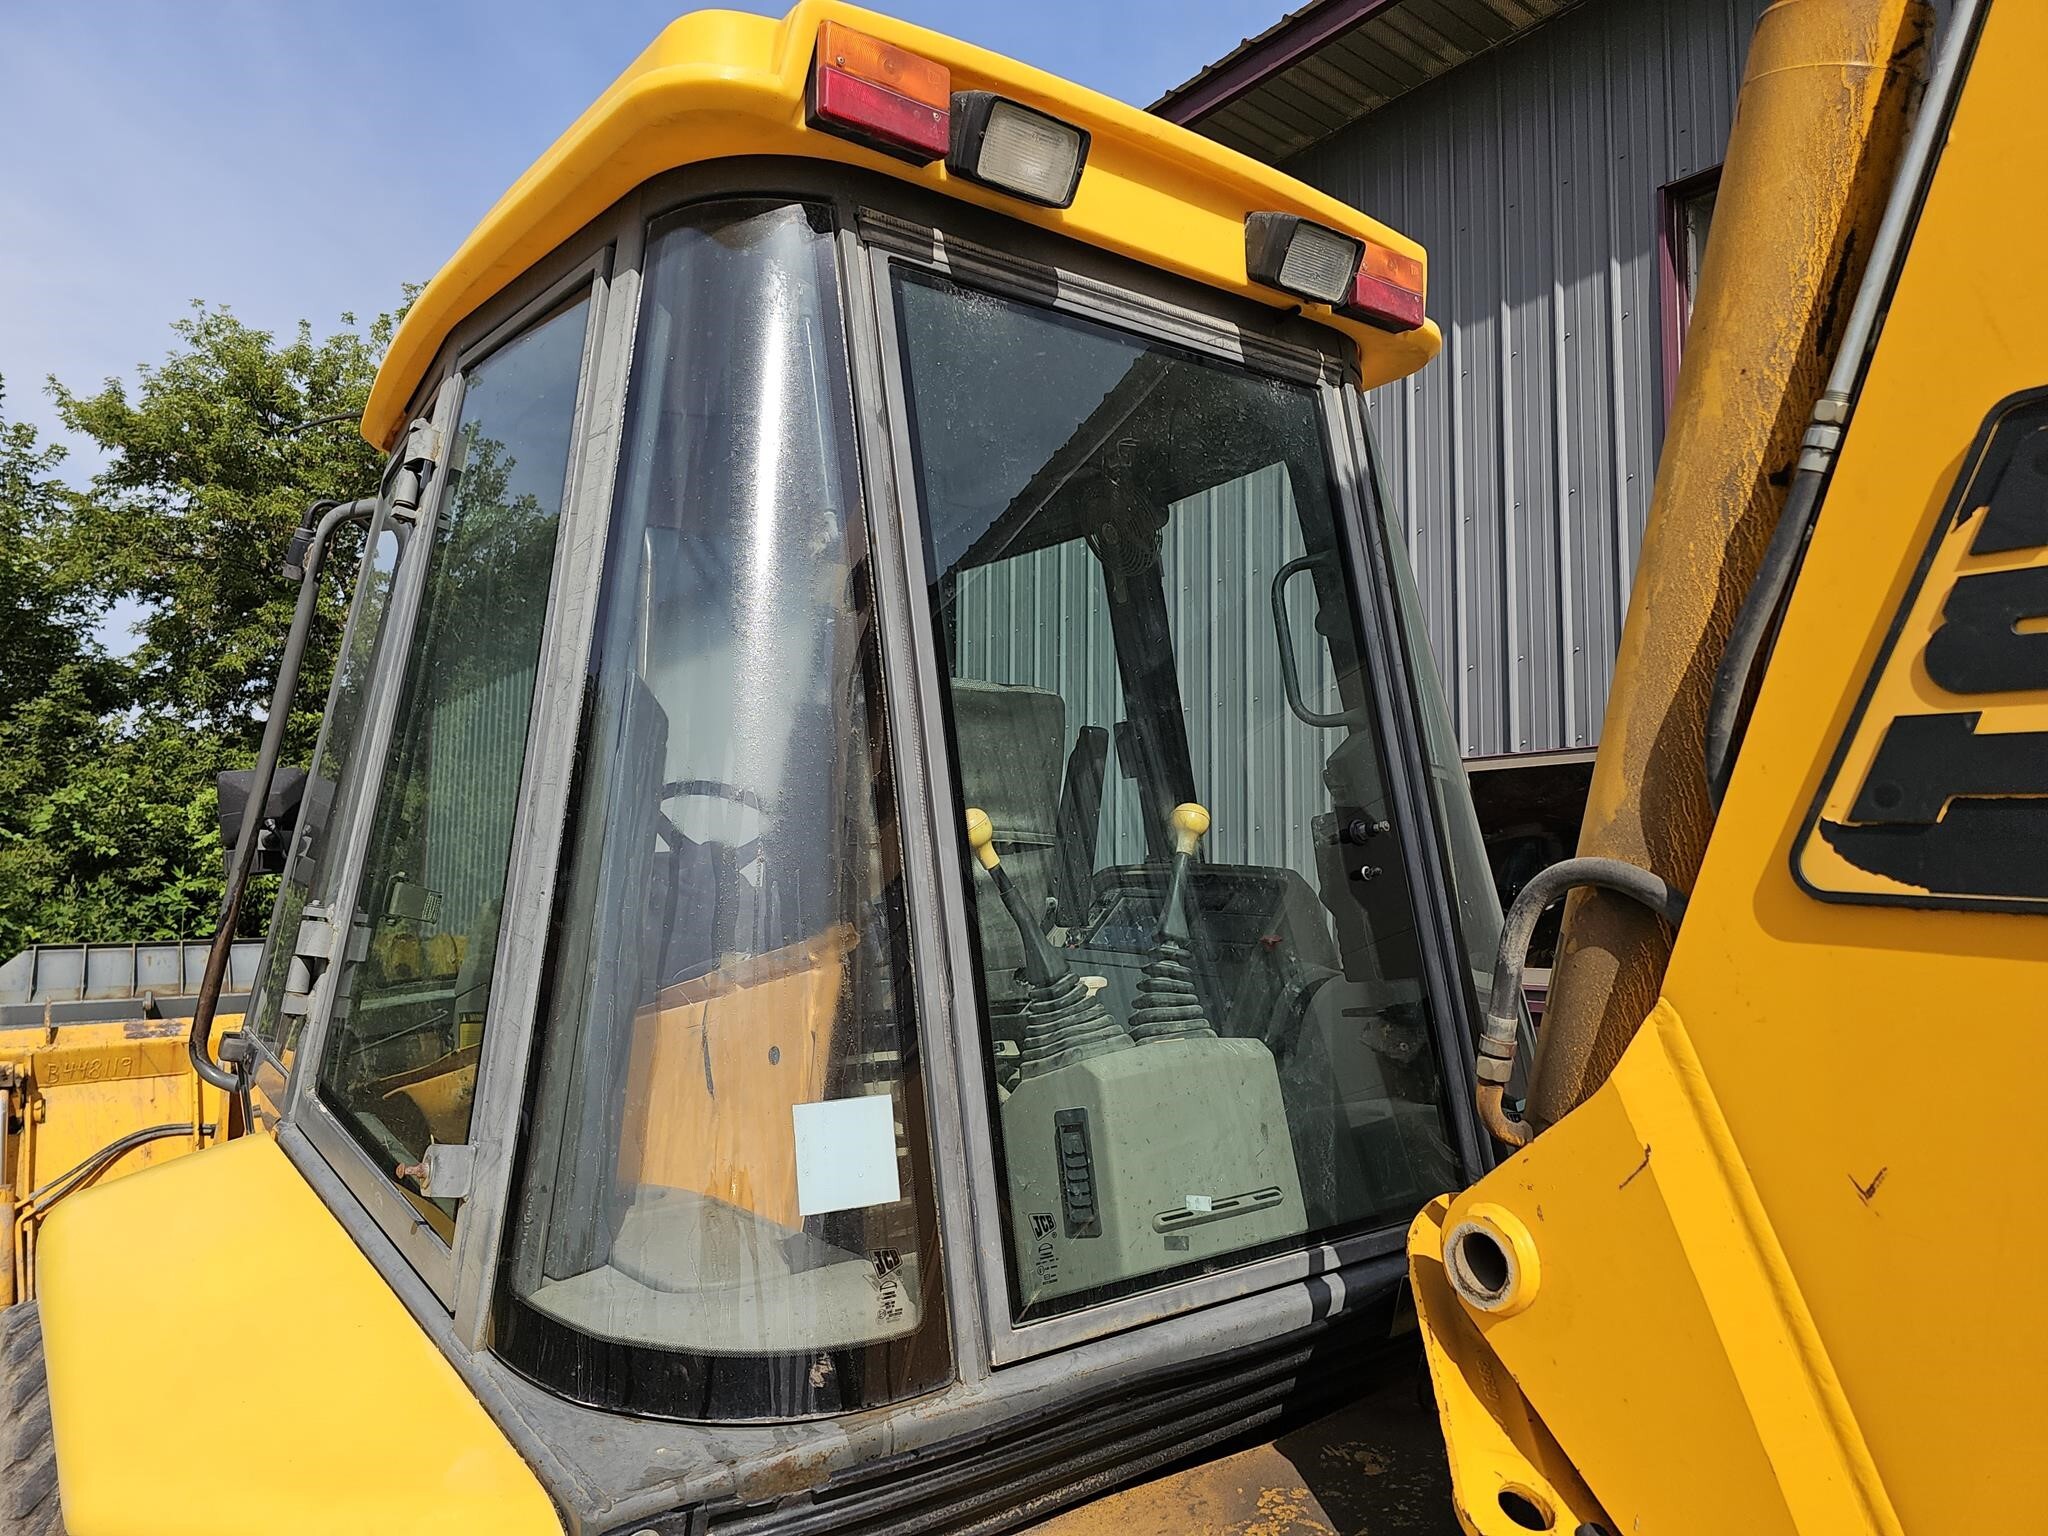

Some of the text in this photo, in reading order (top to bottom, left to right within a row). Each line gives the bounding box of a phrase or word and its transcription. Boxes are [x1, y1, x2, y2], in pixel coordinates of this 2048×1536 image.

[47, 1057, 133, 1084] B448119
[1033, 1215, 1055, 1238] JCB
[874, 1250, 901, 1276] JCB
